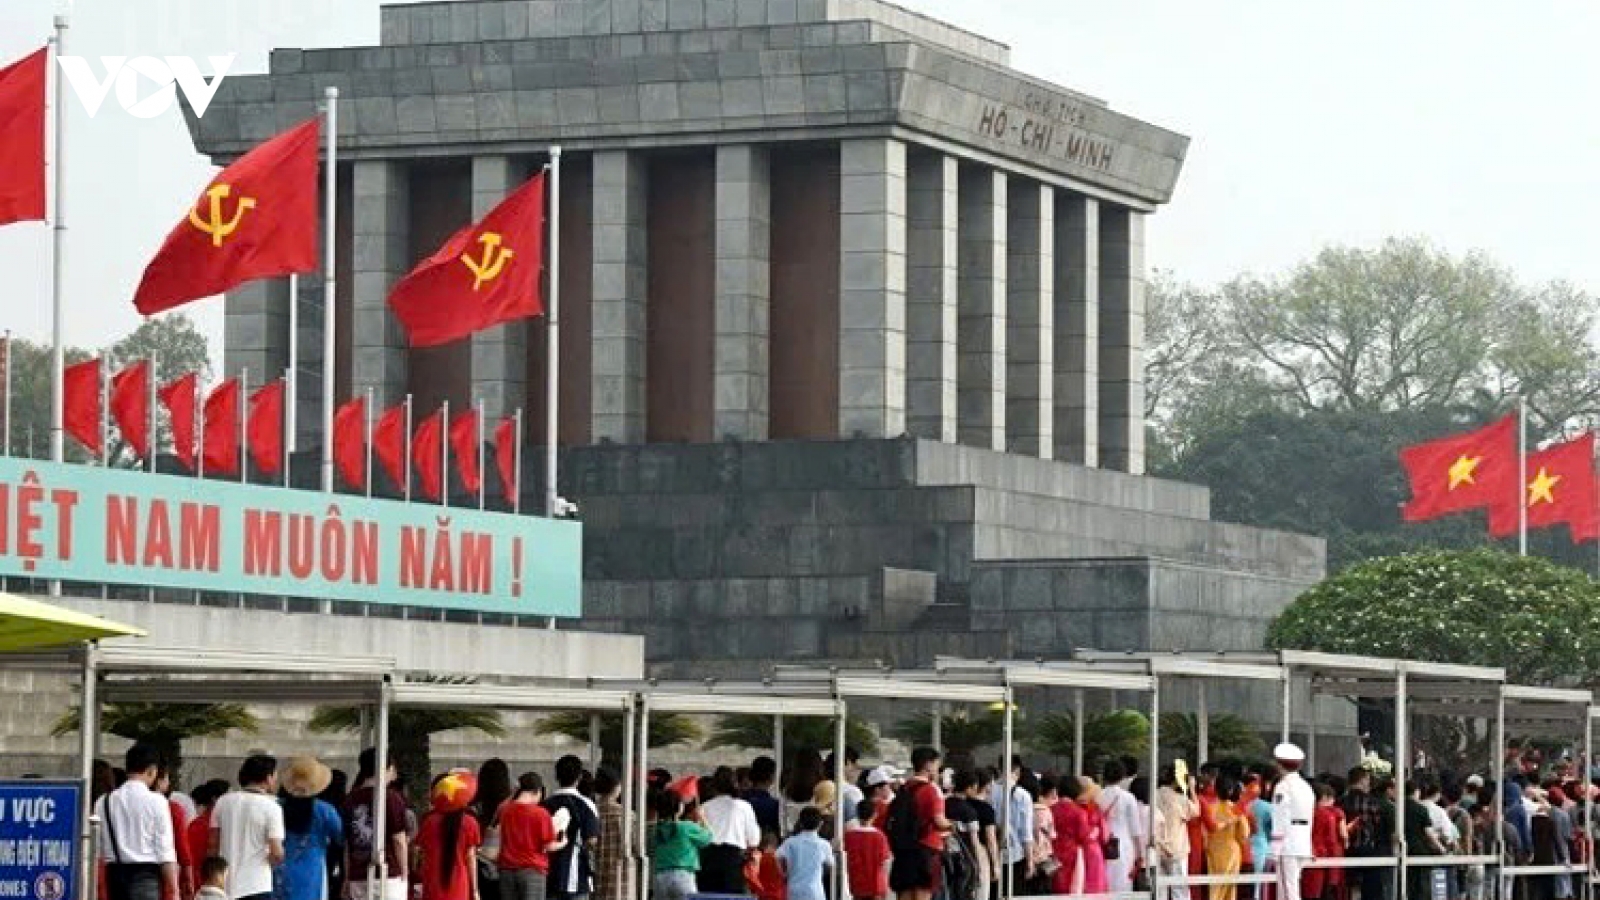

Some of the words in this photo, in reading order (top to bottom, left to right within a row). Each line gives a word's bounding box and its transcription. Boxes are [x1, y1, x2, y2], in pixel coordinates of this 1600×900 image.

[106, 494, 220, 573] NAM
[243, 503, 379, 585] MUÔN
[400, 515, 492, 594] NĂM
